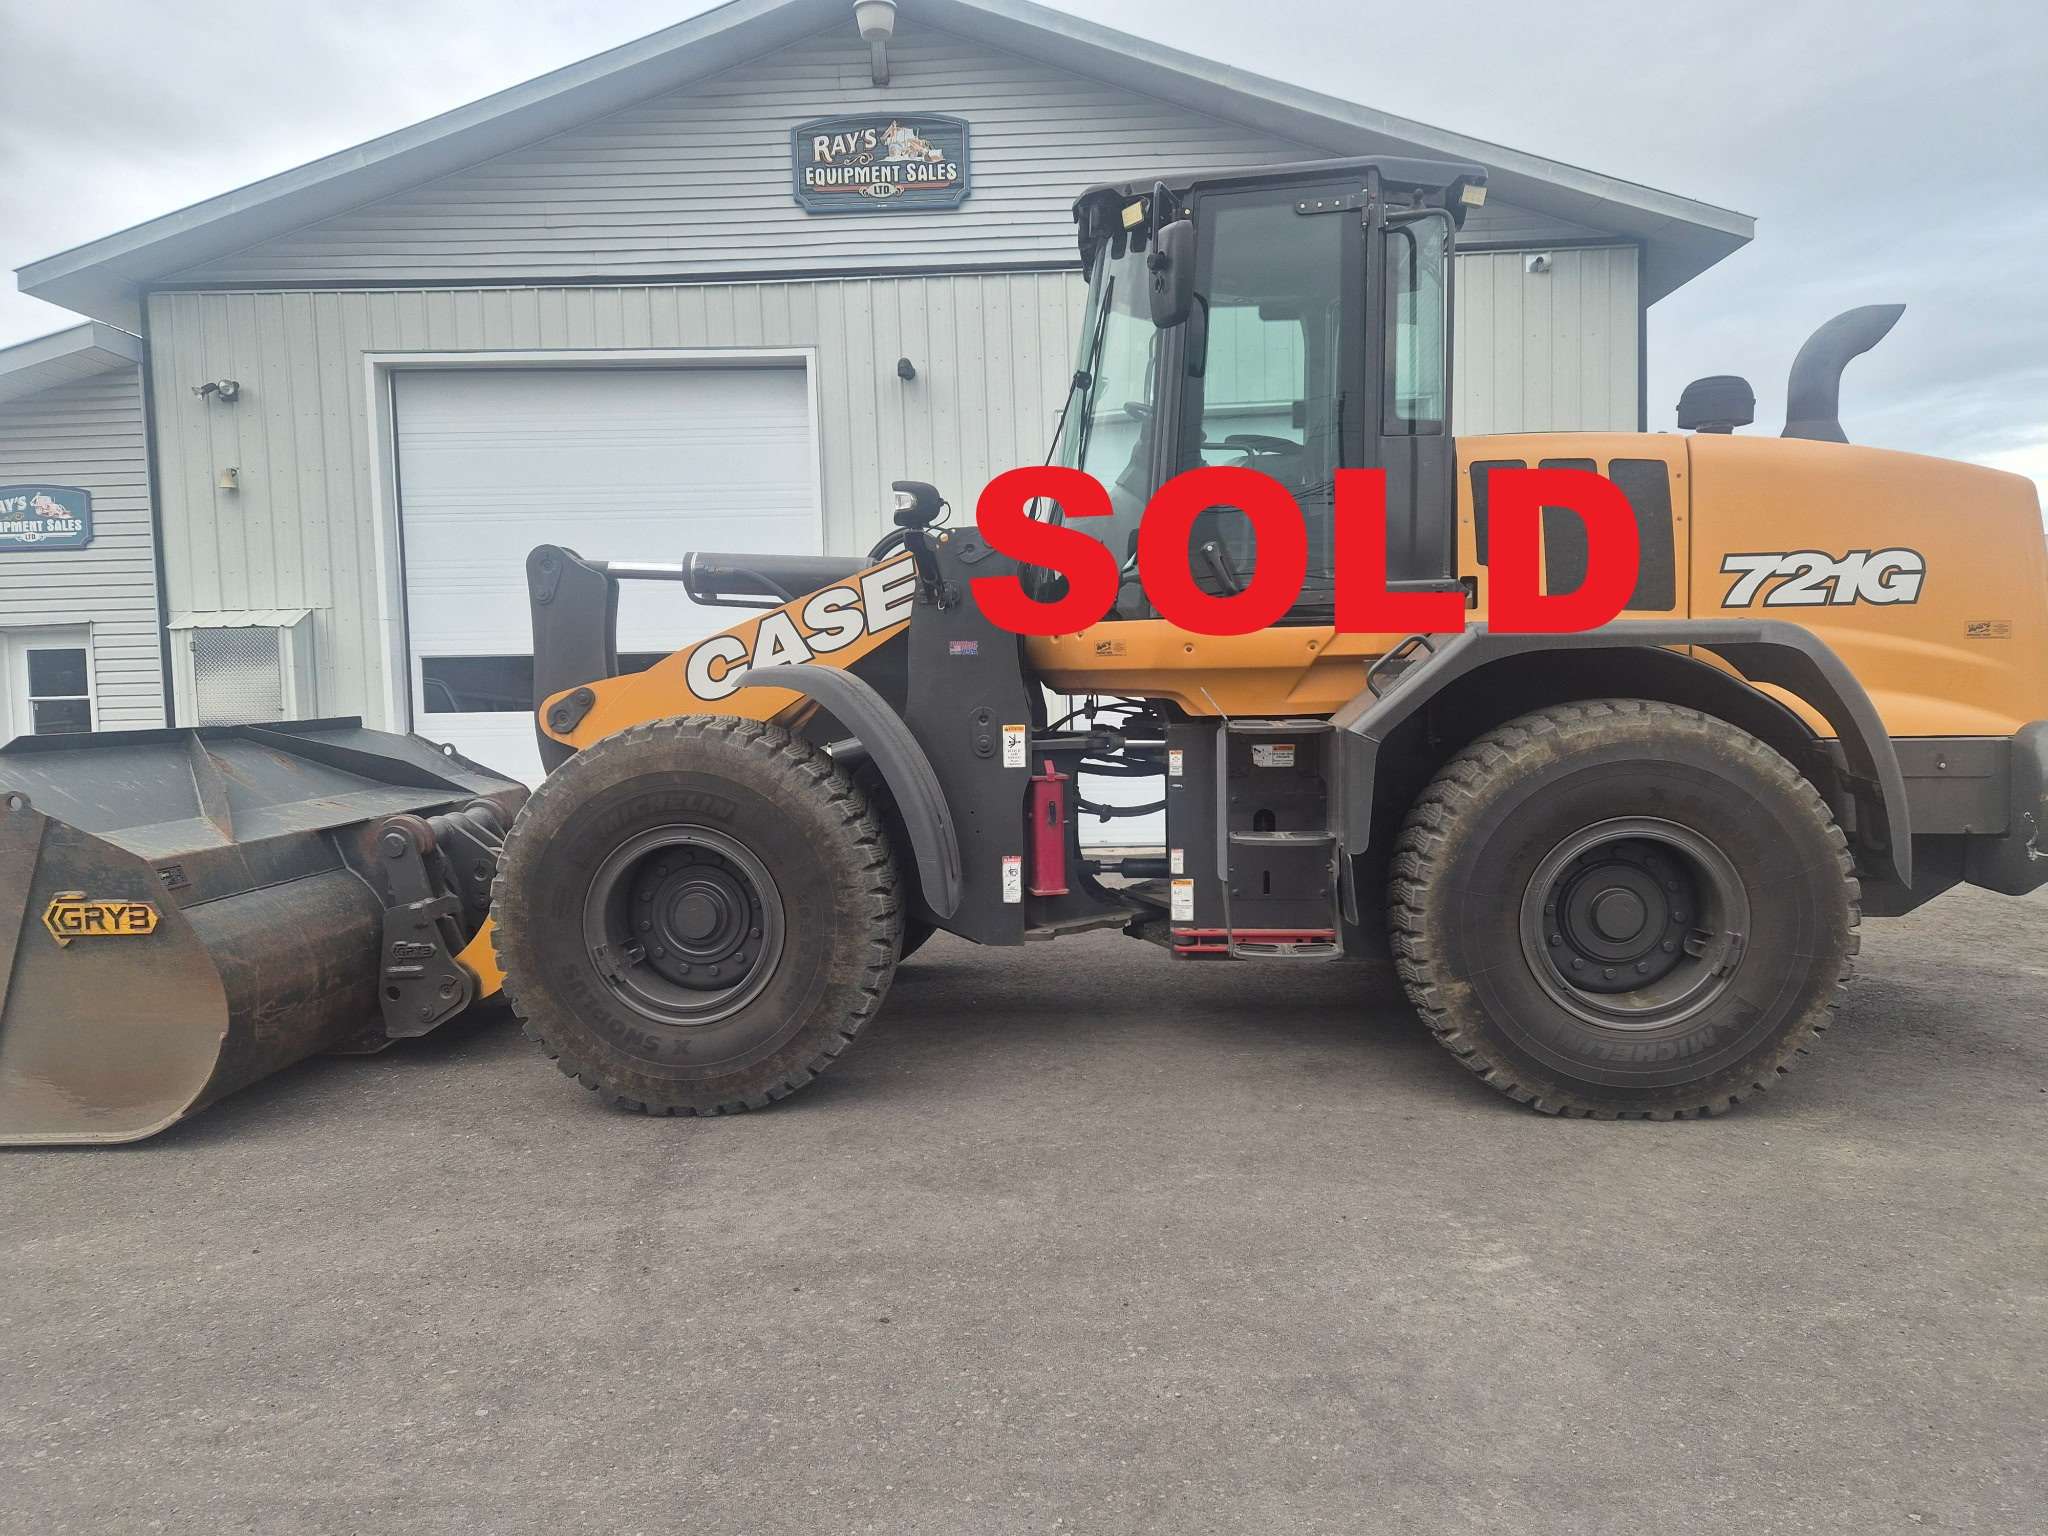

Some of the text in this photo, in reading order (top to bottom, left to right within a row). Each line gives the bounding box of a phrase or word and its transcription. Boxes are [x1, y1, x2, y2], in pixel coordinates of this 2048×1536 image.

[813, 128, 877, 162] RAY'S
[805, 162, 958, 186] EQUIPMENT SALES
[0, 495, 27, 514] AY'S
[0, 519, 82, 533] IPMENT SALES
[1720, 547, 1926, 608] 721G
[685, 554, 917, 701] CASE
